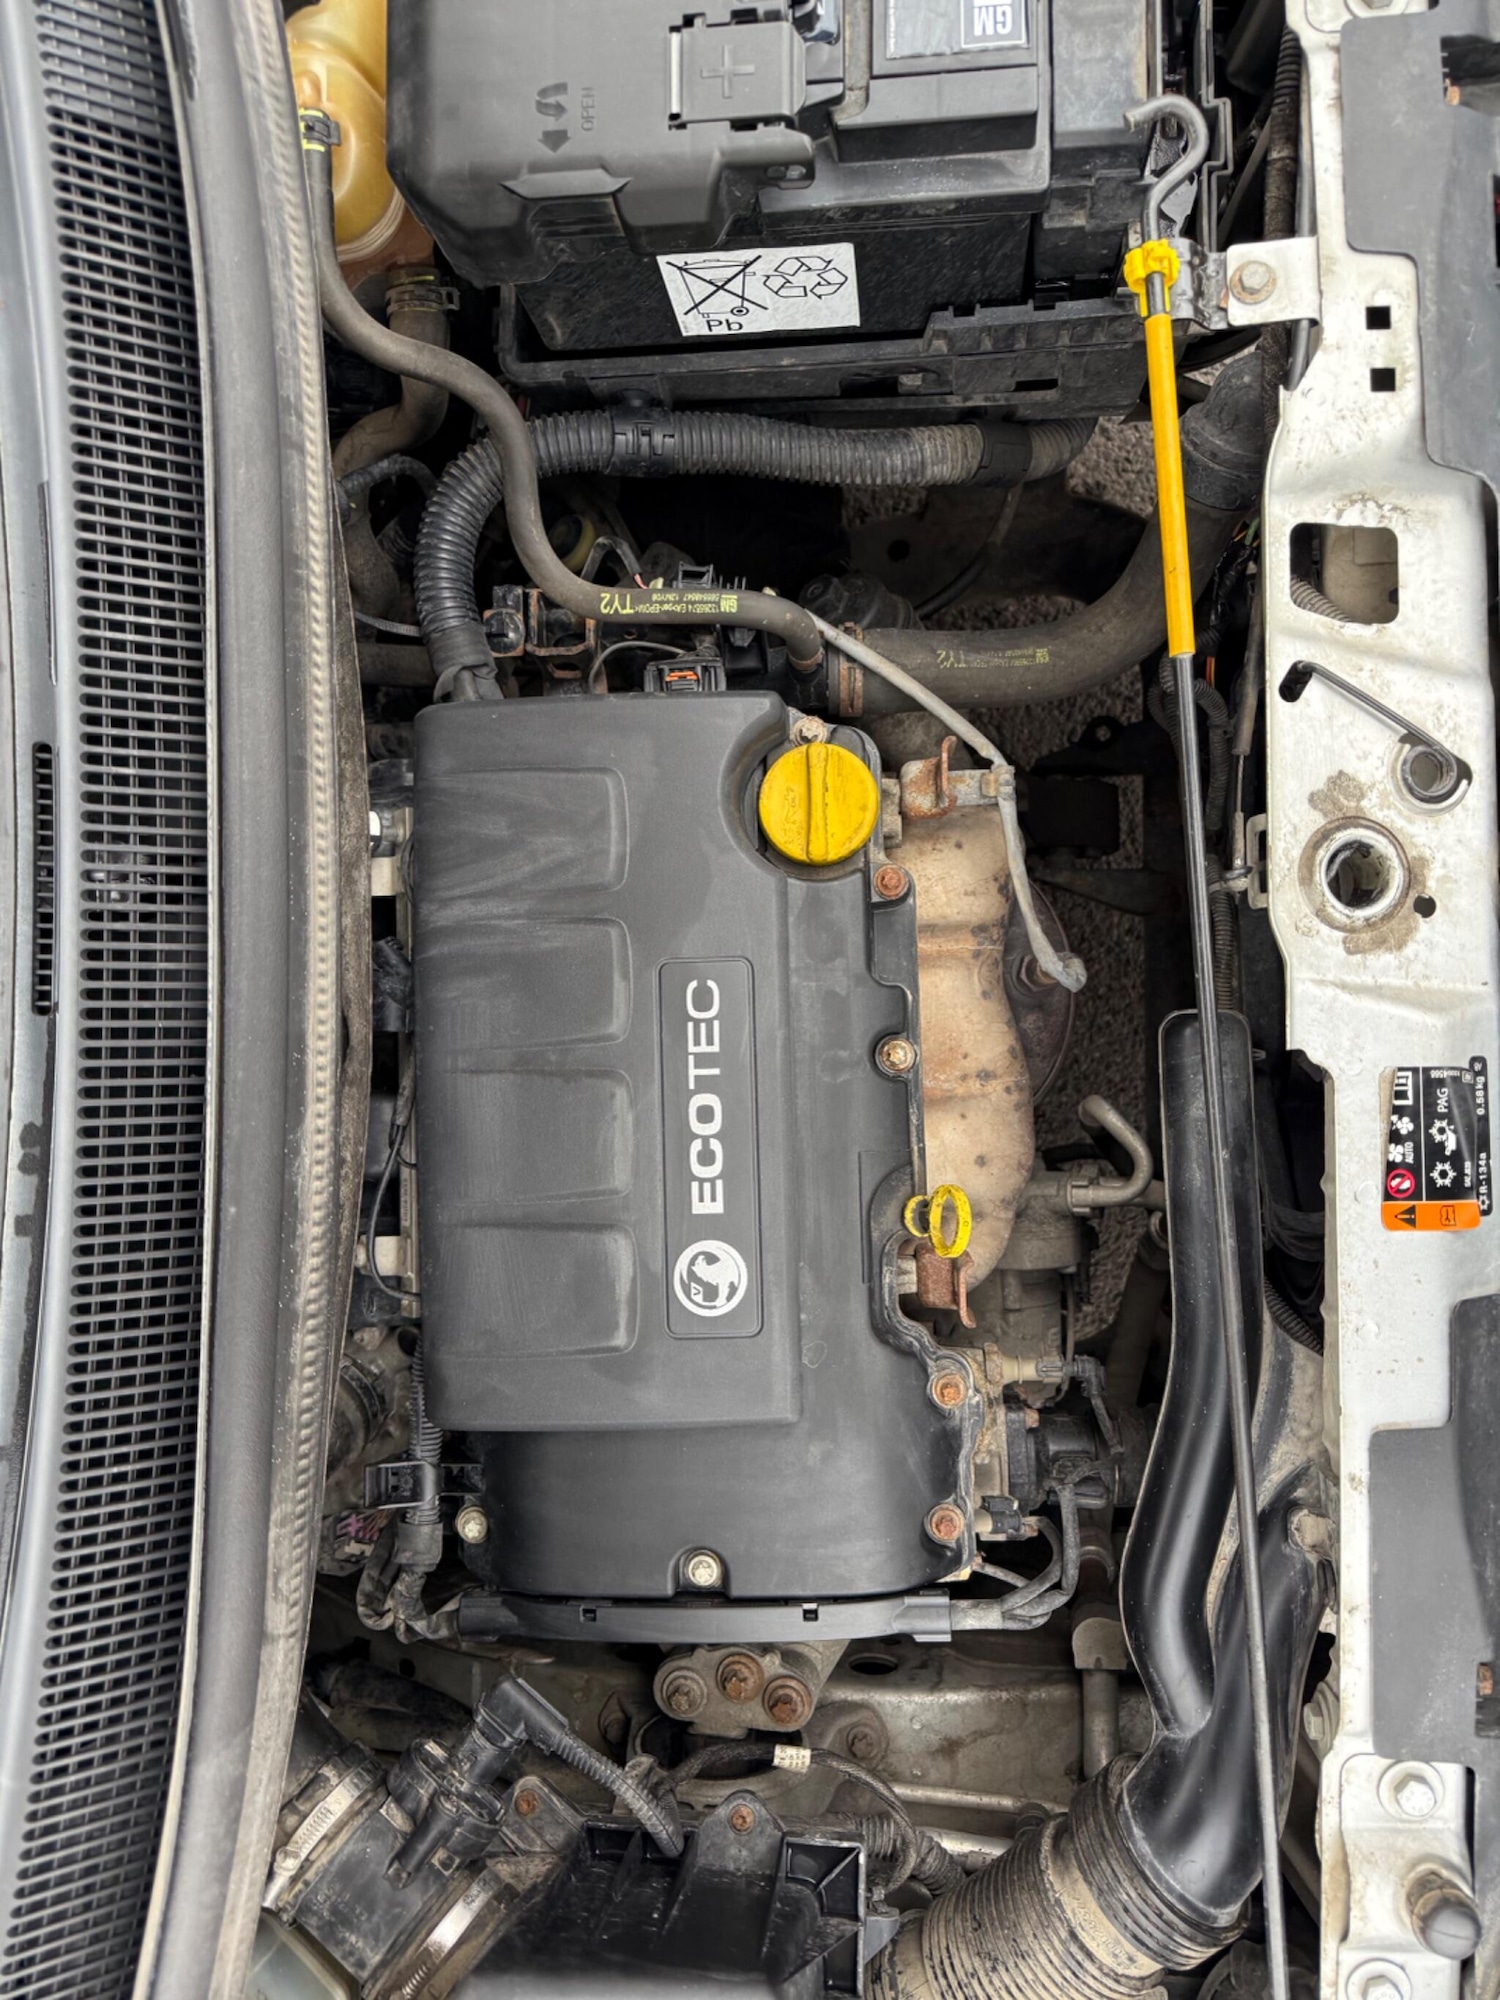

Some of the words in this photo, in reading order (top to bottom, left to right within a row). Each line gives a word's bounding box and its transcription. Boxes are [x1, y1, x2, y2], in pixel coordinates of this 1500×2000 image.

[973, 5, 1013, 36] GM
[580, 87, 595, 132] OPEN
[705, 319, 744, 332] Pb
[600, 593, 634, 614] TY2
[686, 979, 724, 1215] ECOTEC
[1436, 1087, 1449, 1113] PAG
[1404, 1141, 1414, 1164] AUTO
[1478, 1152, 1488, 1194] R-134a
